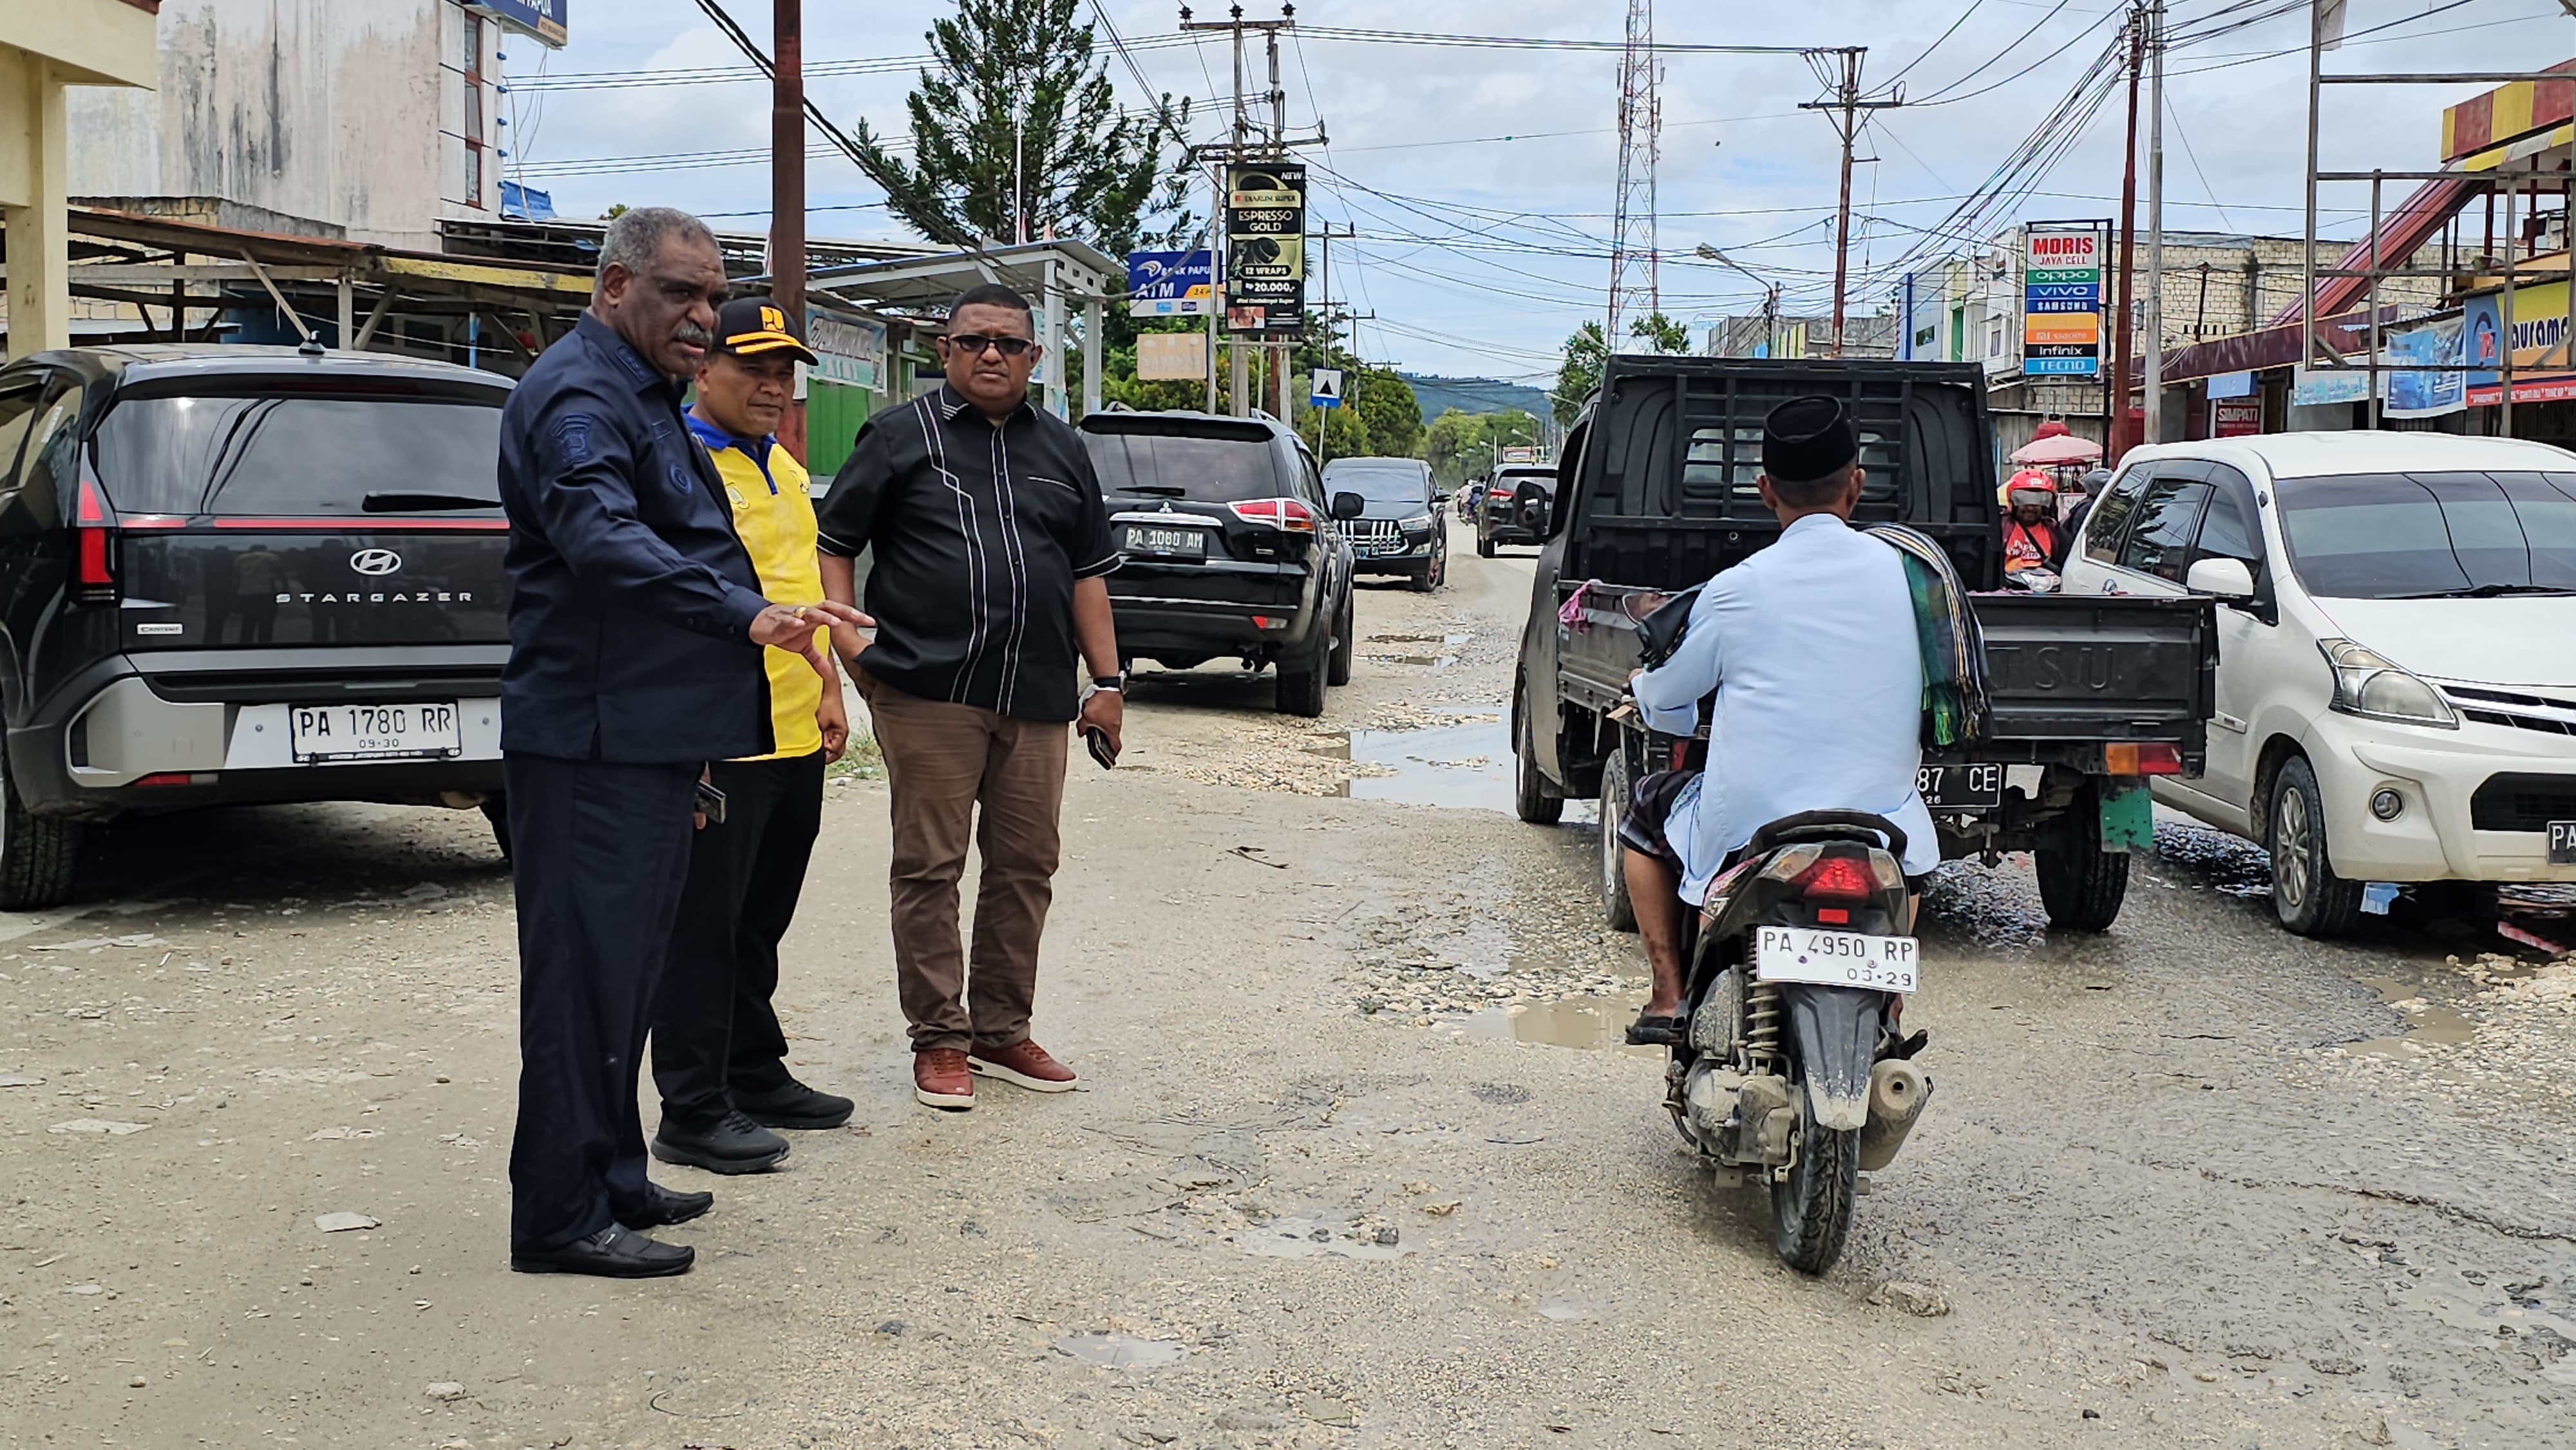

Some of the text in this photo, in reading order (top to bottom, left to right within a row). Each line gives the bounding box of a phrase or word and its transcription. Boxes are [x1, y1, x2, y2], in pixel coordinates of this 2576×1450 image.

[1281, 171, 1302, 180] NEW
[1238, 210, 1293, 221] ESPRESSO
[1249, 222, 1282, 231] GOLD
[2032, 237, 2093, 255] MORIS
[2039, 256, 2087, 265] JAYA CELL
[1188, 265, 1211, 275] PAPU
[1256, 267, 1287, 275] WRAPS
[2036, 270, 2090, 281] oppo
[1135, 282, 1175, 298] ATM
[2038, 287, 2088, 296] vivo
[2037, 301, 2088, 311] SAMSUNG
[2040, 361, 2085, 371] TECNO
[2218, 407, 2259, 422] SIMPATI
[1128, 529, 1143, 544] PA
[1186, 532, 1204, 548] AM
[276, 592, 472, 603] STARGAZER
[1987, 646, 2113, 689] TSU
[299, 708, 451, 737] PA 1780 RR
[1917, 766, 1997, 793] 87 CE
[2551, 825, 2576, 851] PA
[1763, 931, 1913, 962] PA 4950 RP
